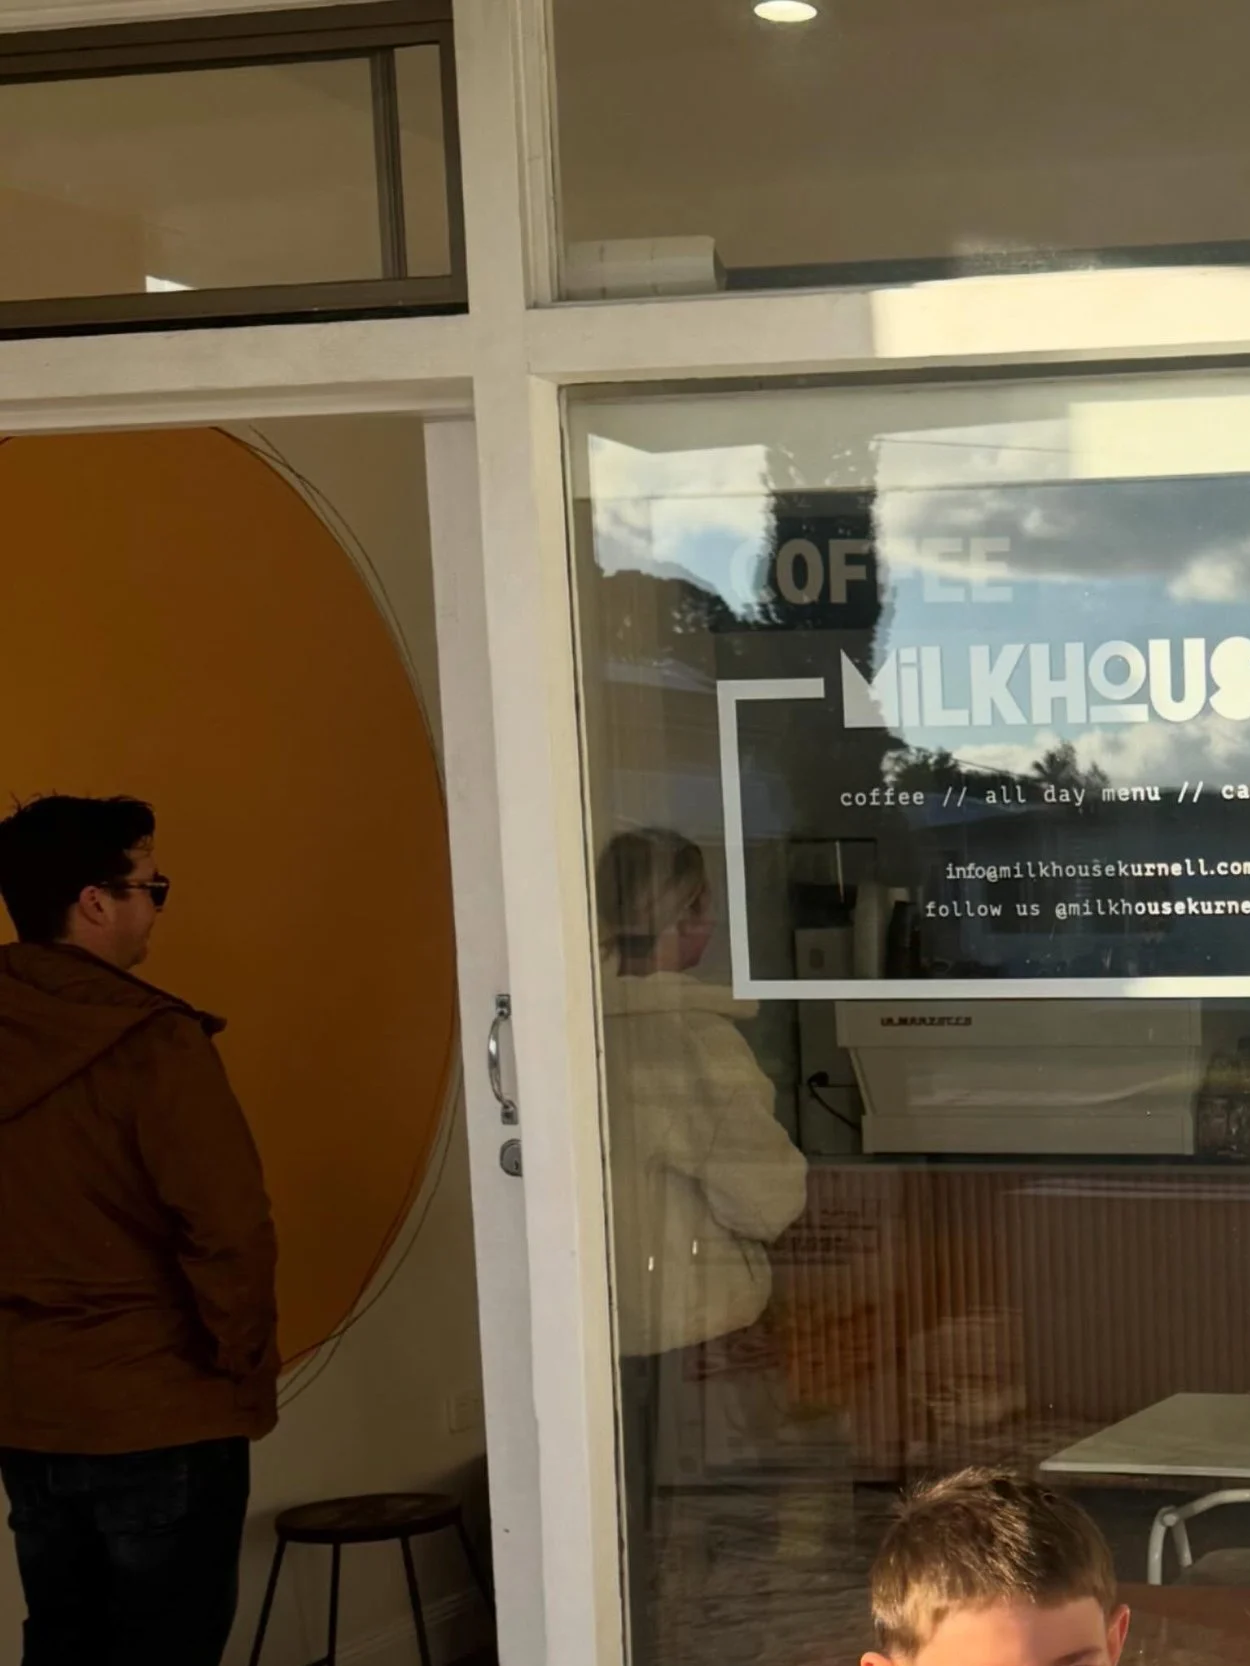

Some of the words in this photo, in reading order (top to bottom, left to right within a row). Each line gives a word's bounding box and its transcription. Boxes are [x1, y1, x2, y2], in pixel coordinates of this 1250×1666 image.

[840, 787, 925, 806] coffee
[985, 785, 1027, 805] all
[1044, 785, 1086, 806] day
[1101, 786, 1162, 803] menu
[926, 901, 1002, 917] follow
[1016, 902, 1041, 916] us
